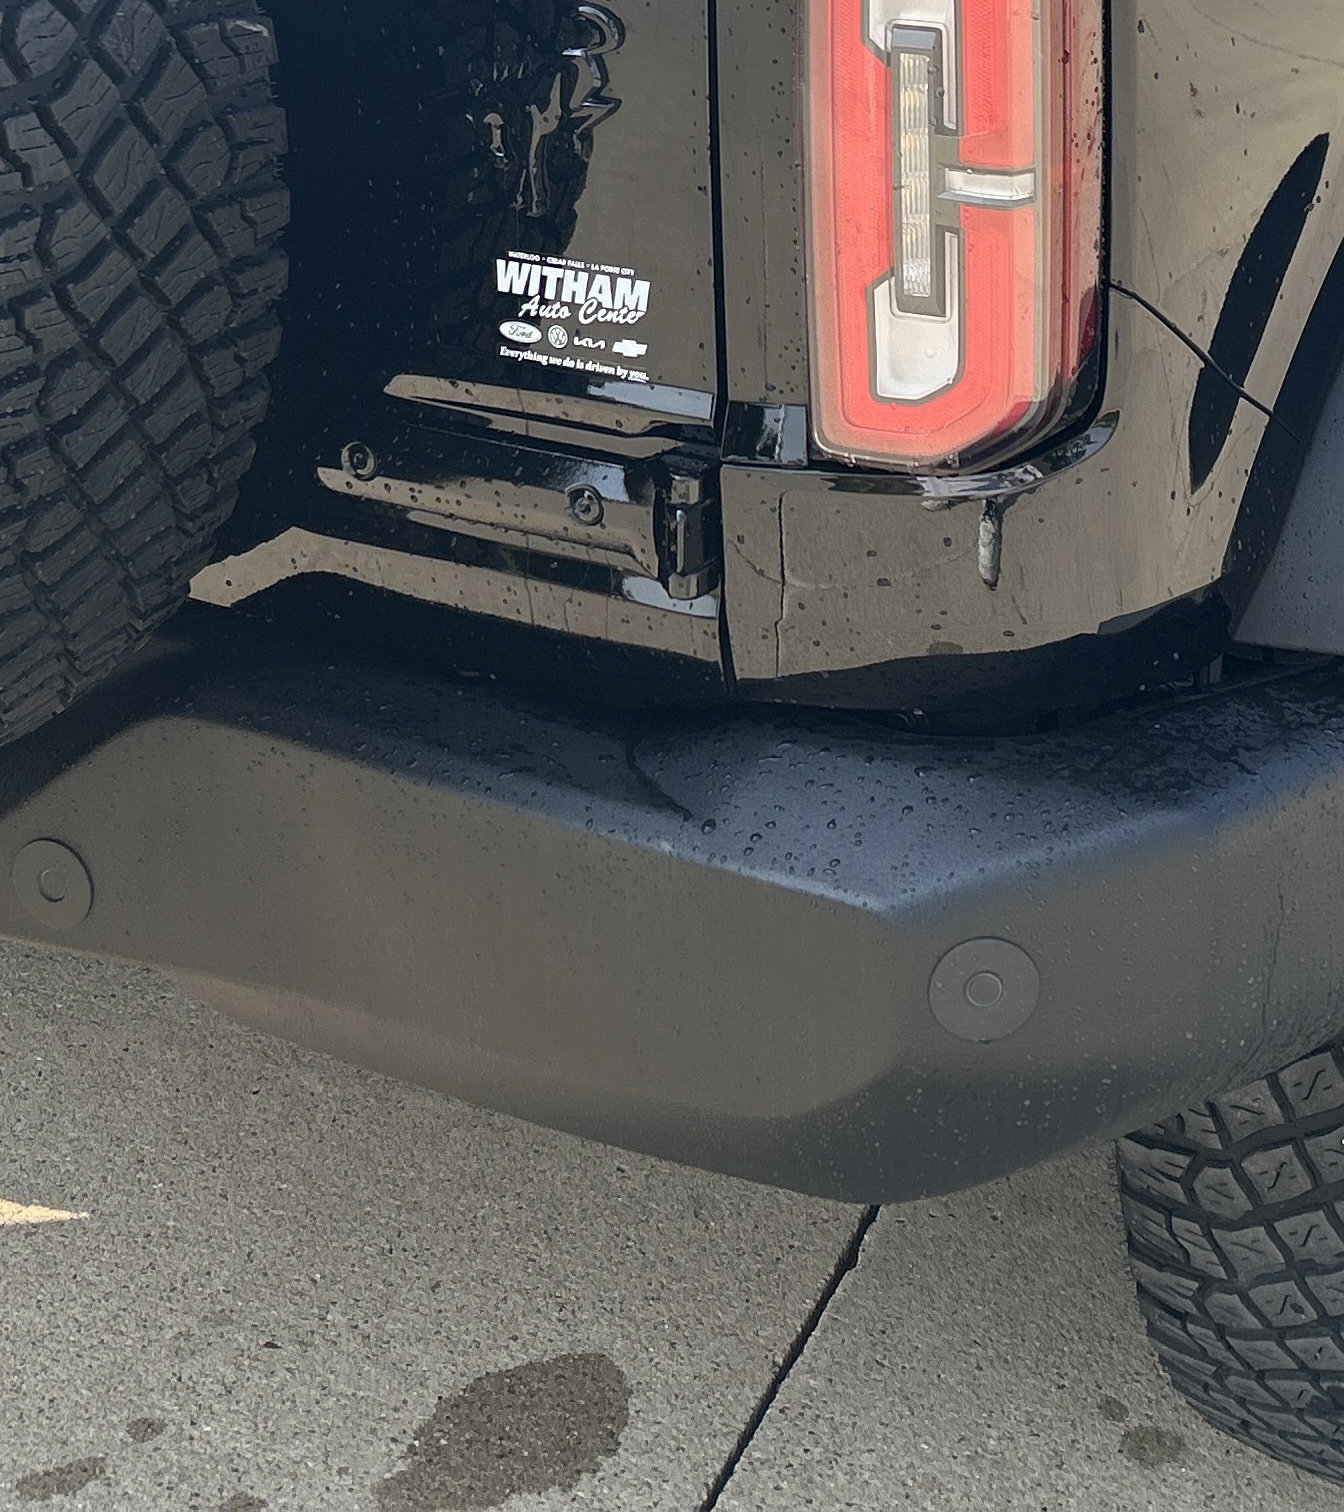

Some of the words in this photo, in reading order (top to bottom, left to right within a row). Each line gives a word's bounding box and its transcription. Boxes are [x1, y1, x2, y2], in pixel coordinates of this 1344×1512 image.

[496, 259, 651, 313] WITHAM
[518, 294, 571, 318] Auto
[499, 346, 549, 366] Everything
[548, 356, 563, 365] we
[562, 357, 576, 369] do
[584, 361, 616, 376] driven
[616, 366, 629, 379] by
